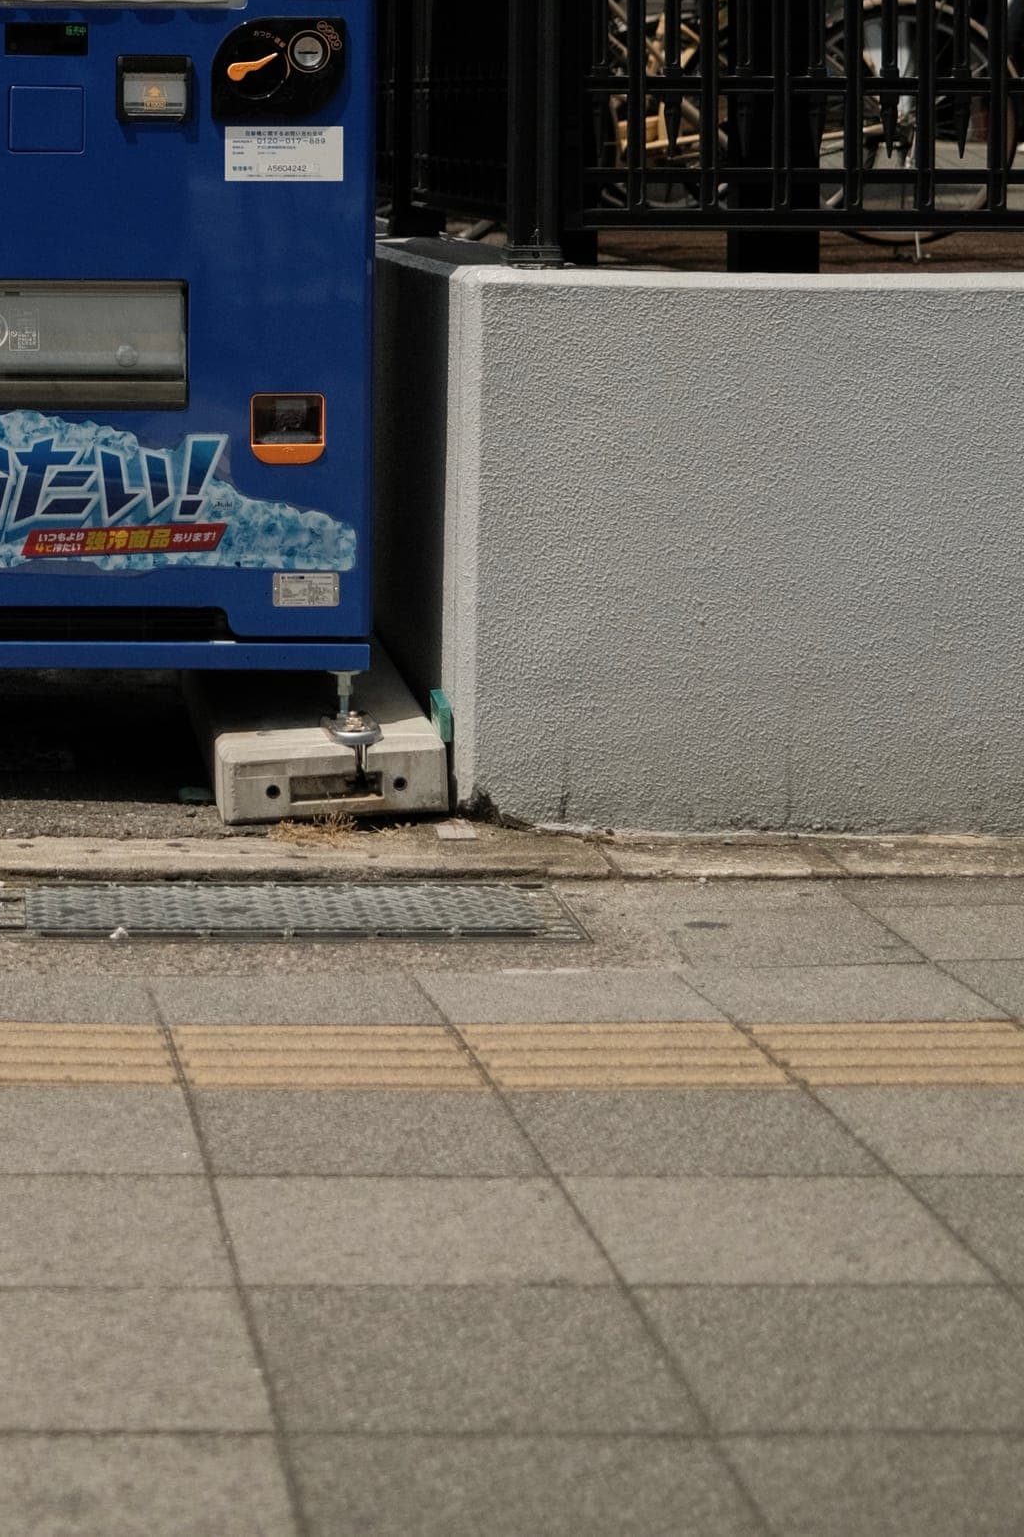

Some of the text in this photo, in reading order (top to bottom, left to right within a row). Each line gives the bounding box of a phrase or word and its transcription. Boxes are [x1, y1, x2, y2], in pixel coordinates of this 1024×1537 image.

[38, 528, 217, 550] いつもより 強冷商品 あります!
